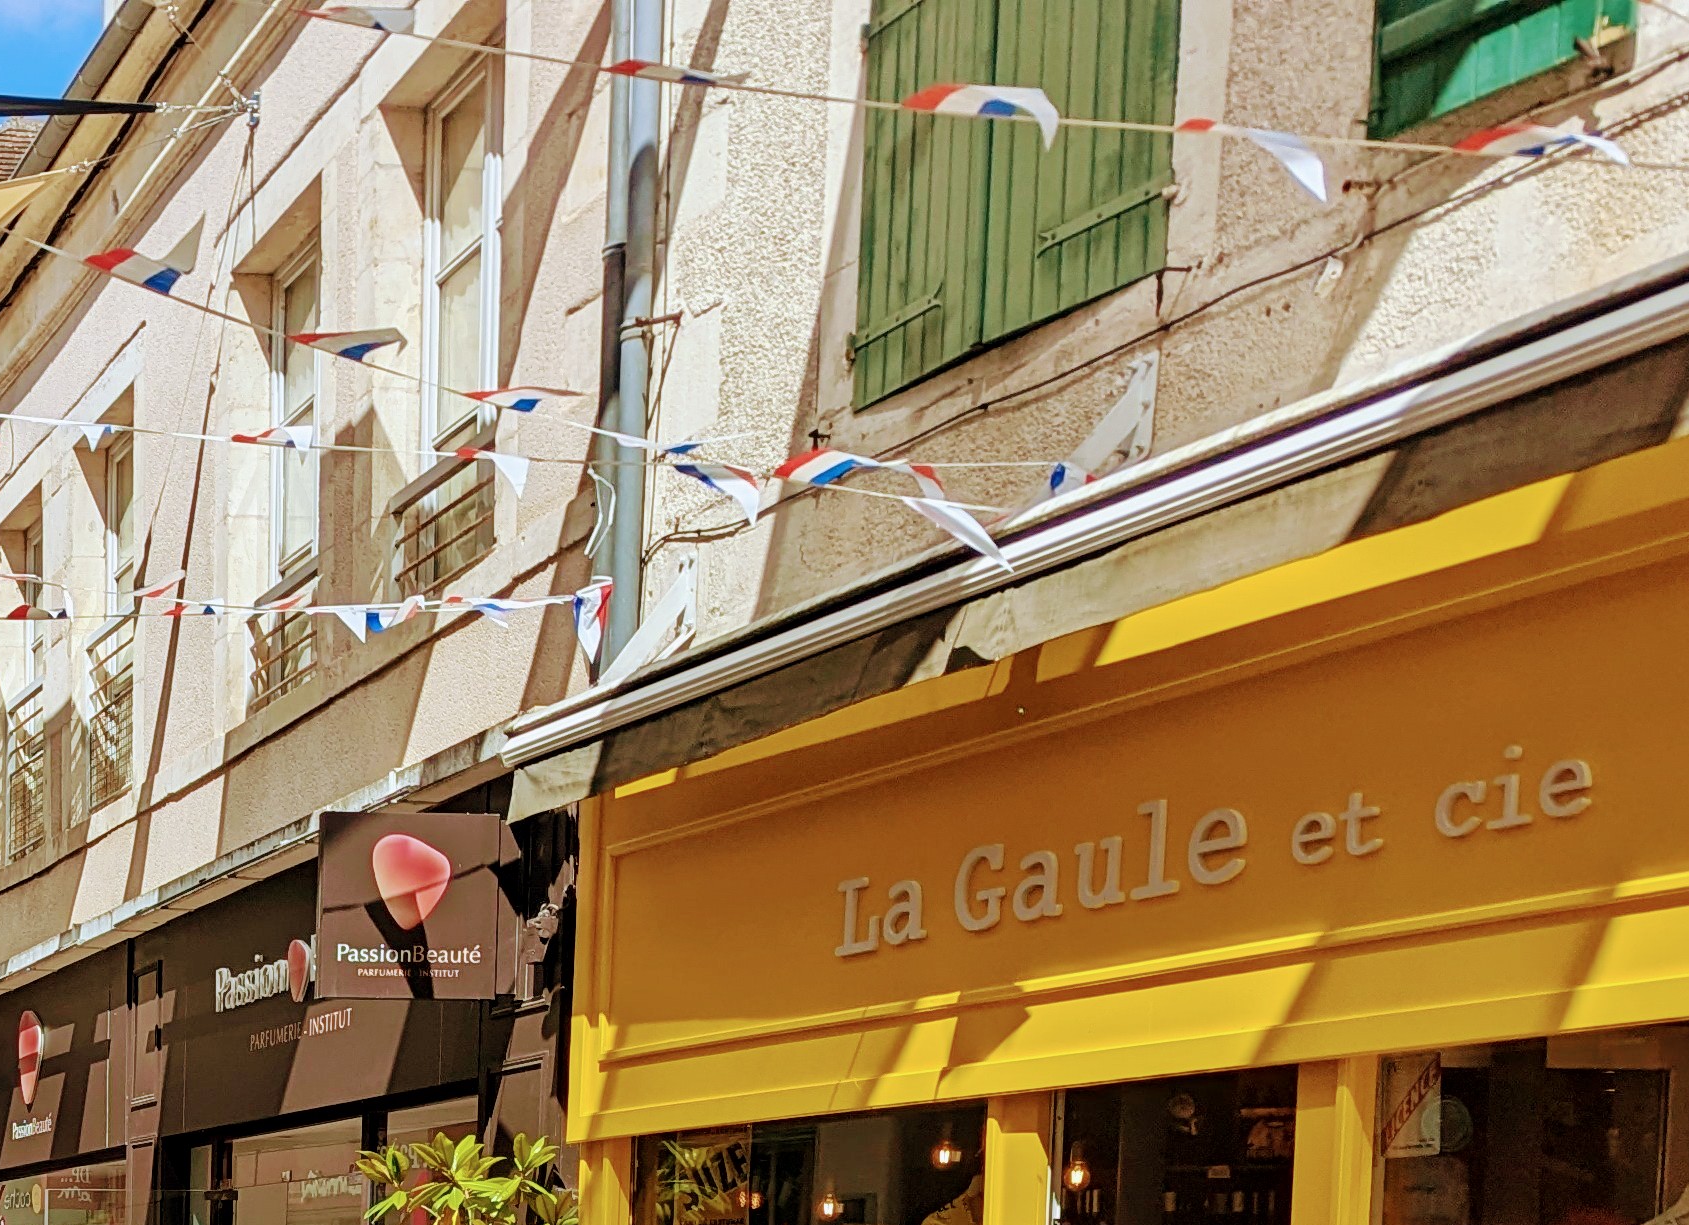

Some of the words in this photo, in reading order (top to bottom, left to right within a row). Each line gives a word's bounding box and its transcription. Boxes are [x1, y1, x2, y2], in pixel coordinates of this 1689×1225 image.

[834, 875, 927, 958] La
[953, 798, 1249, 933] Gaule
[1289, 791, 1383, 866] et
[1434, 745, 1595, 839] cie
[336, 943, 482, 964] PassionBeauté
[215, 953, 288, 1013] Passion
[250, 1021, 302, 1051] PARFUMERIE
[308, 1007, 353, 1037] INSTITUT
